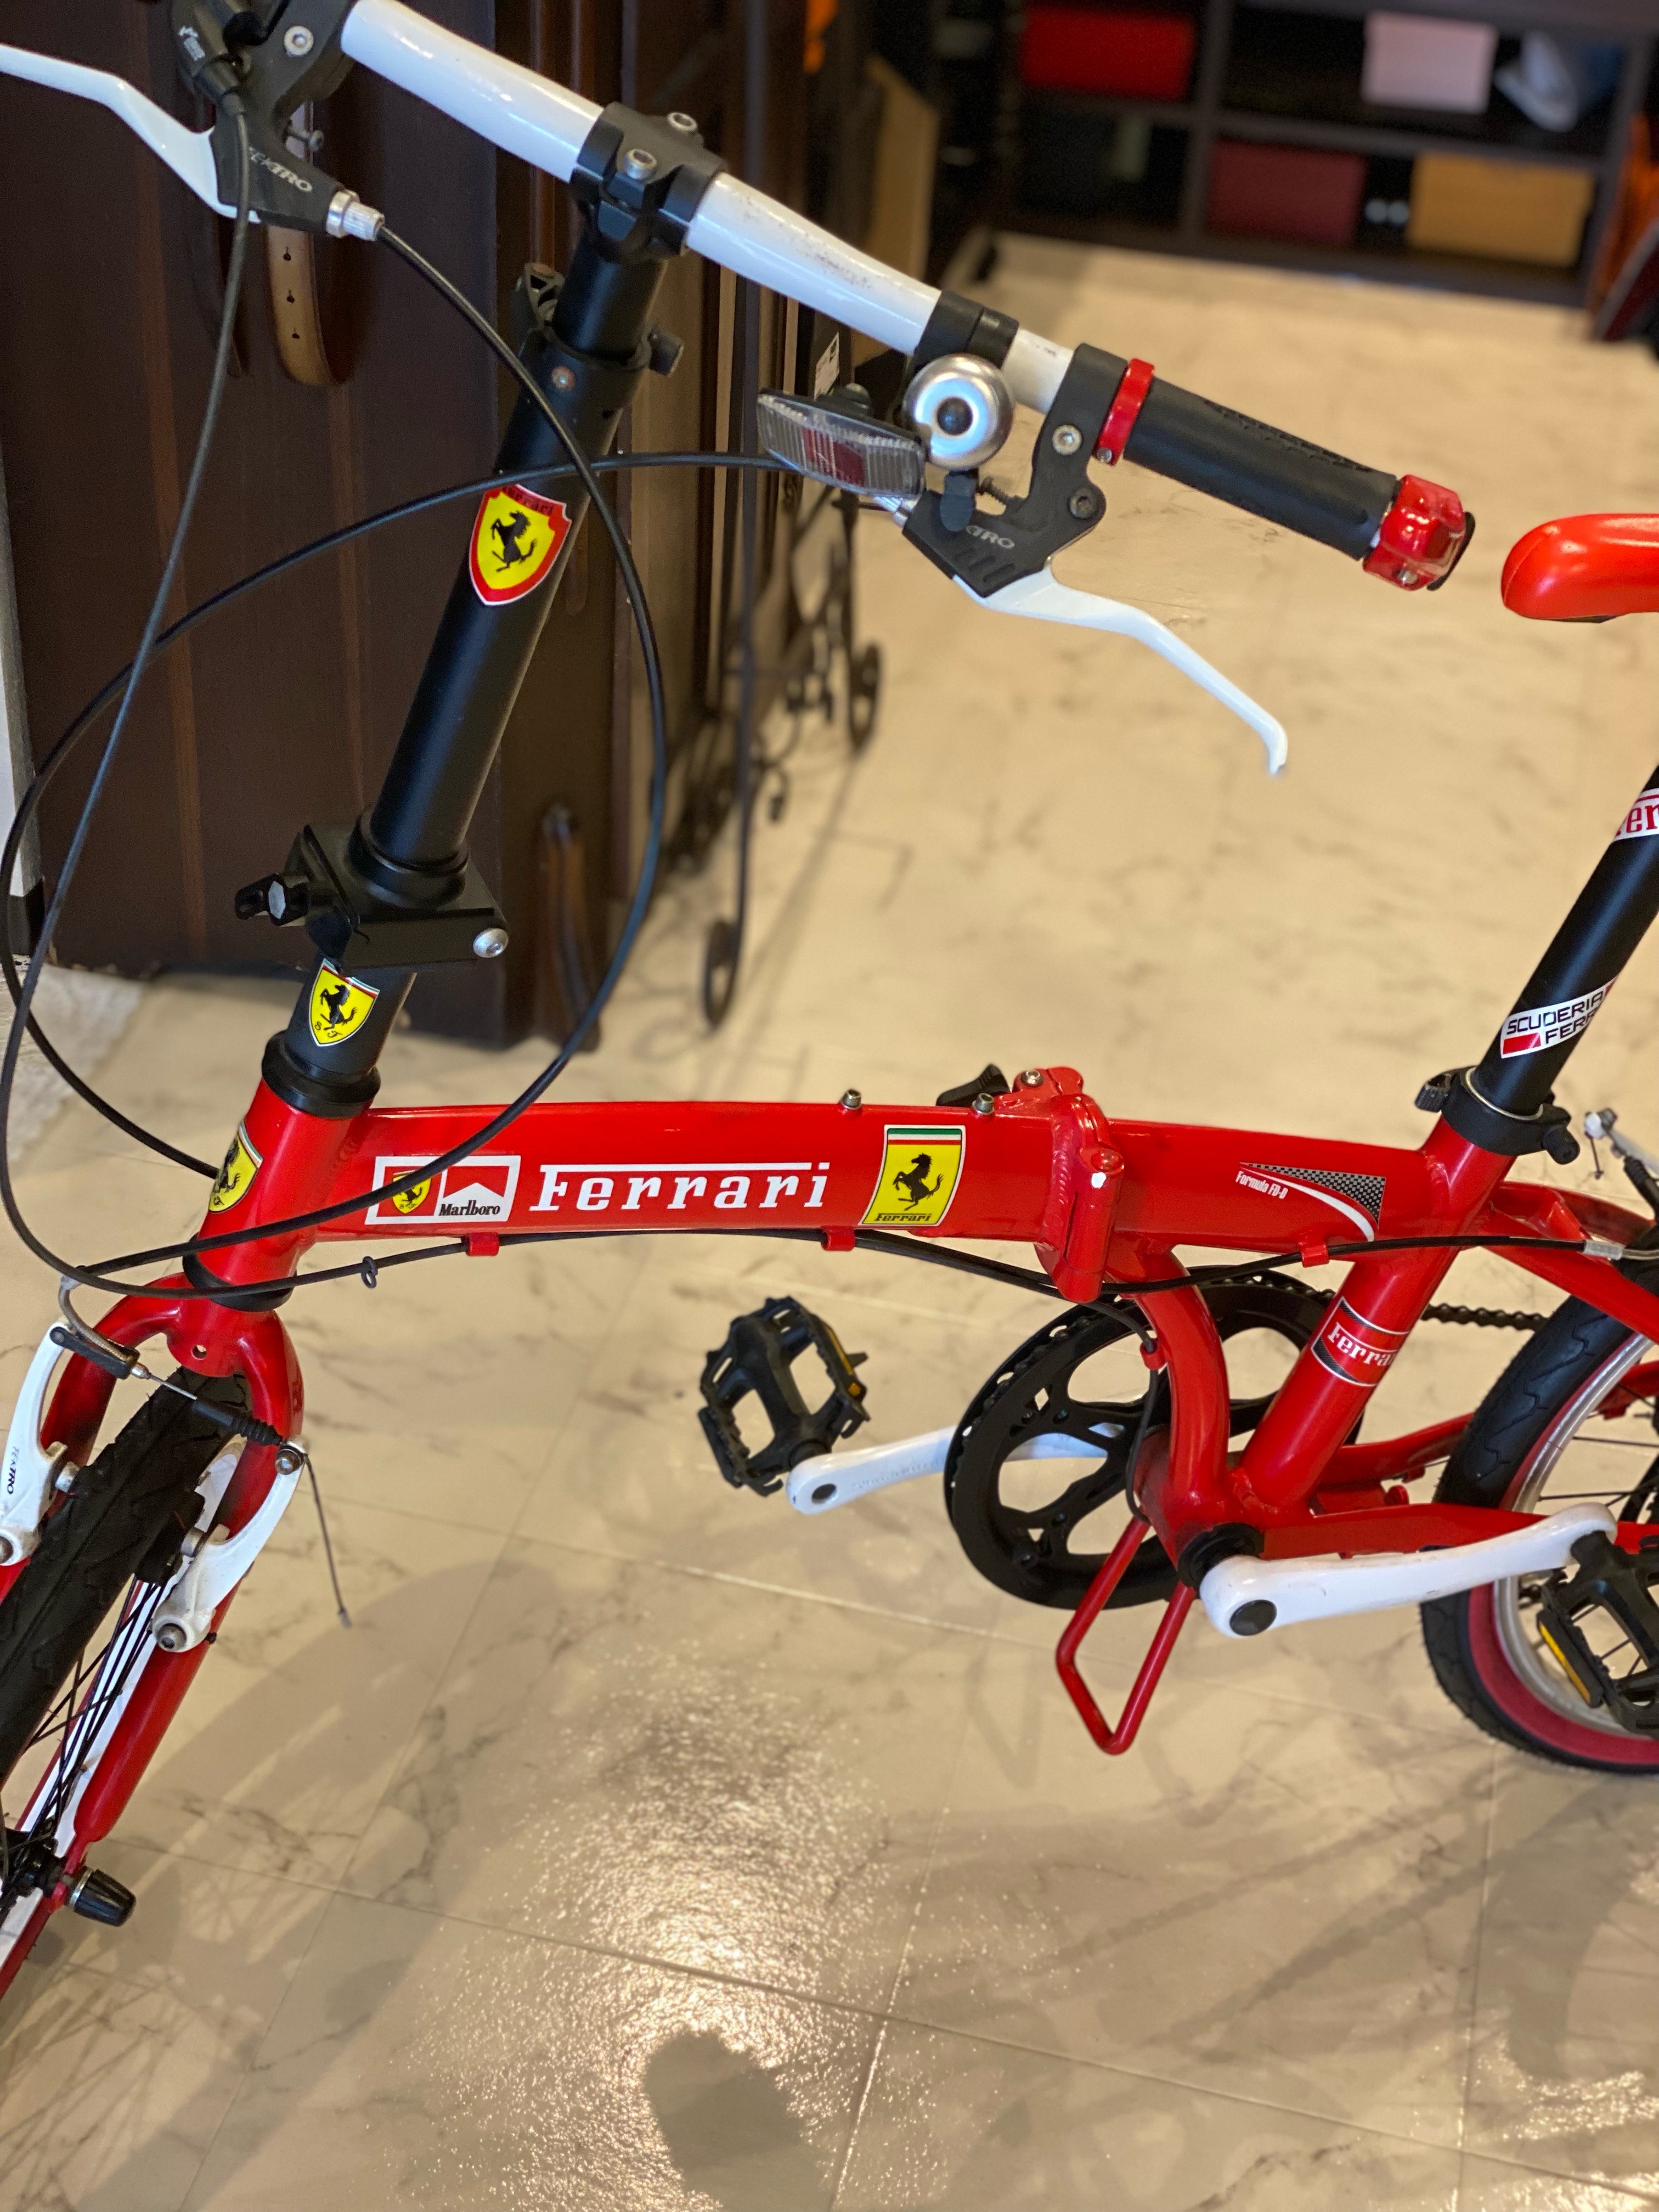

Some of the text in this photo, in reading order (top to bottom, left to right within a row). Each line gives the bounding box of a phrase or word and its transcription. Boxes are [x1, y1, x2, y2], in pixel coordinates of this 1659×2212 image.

[1506, 990, 1604, 1035] SCUDERIA
[1545, 1007, 1598, 1045] FERR
[529, 1162, 830, 1211] Ferrari
[1235, 1170, 1269, 1193] Formula
[438, 1200, 501, 1216] Marlboro
[874, 1213, 933, 1222] Ferrari
